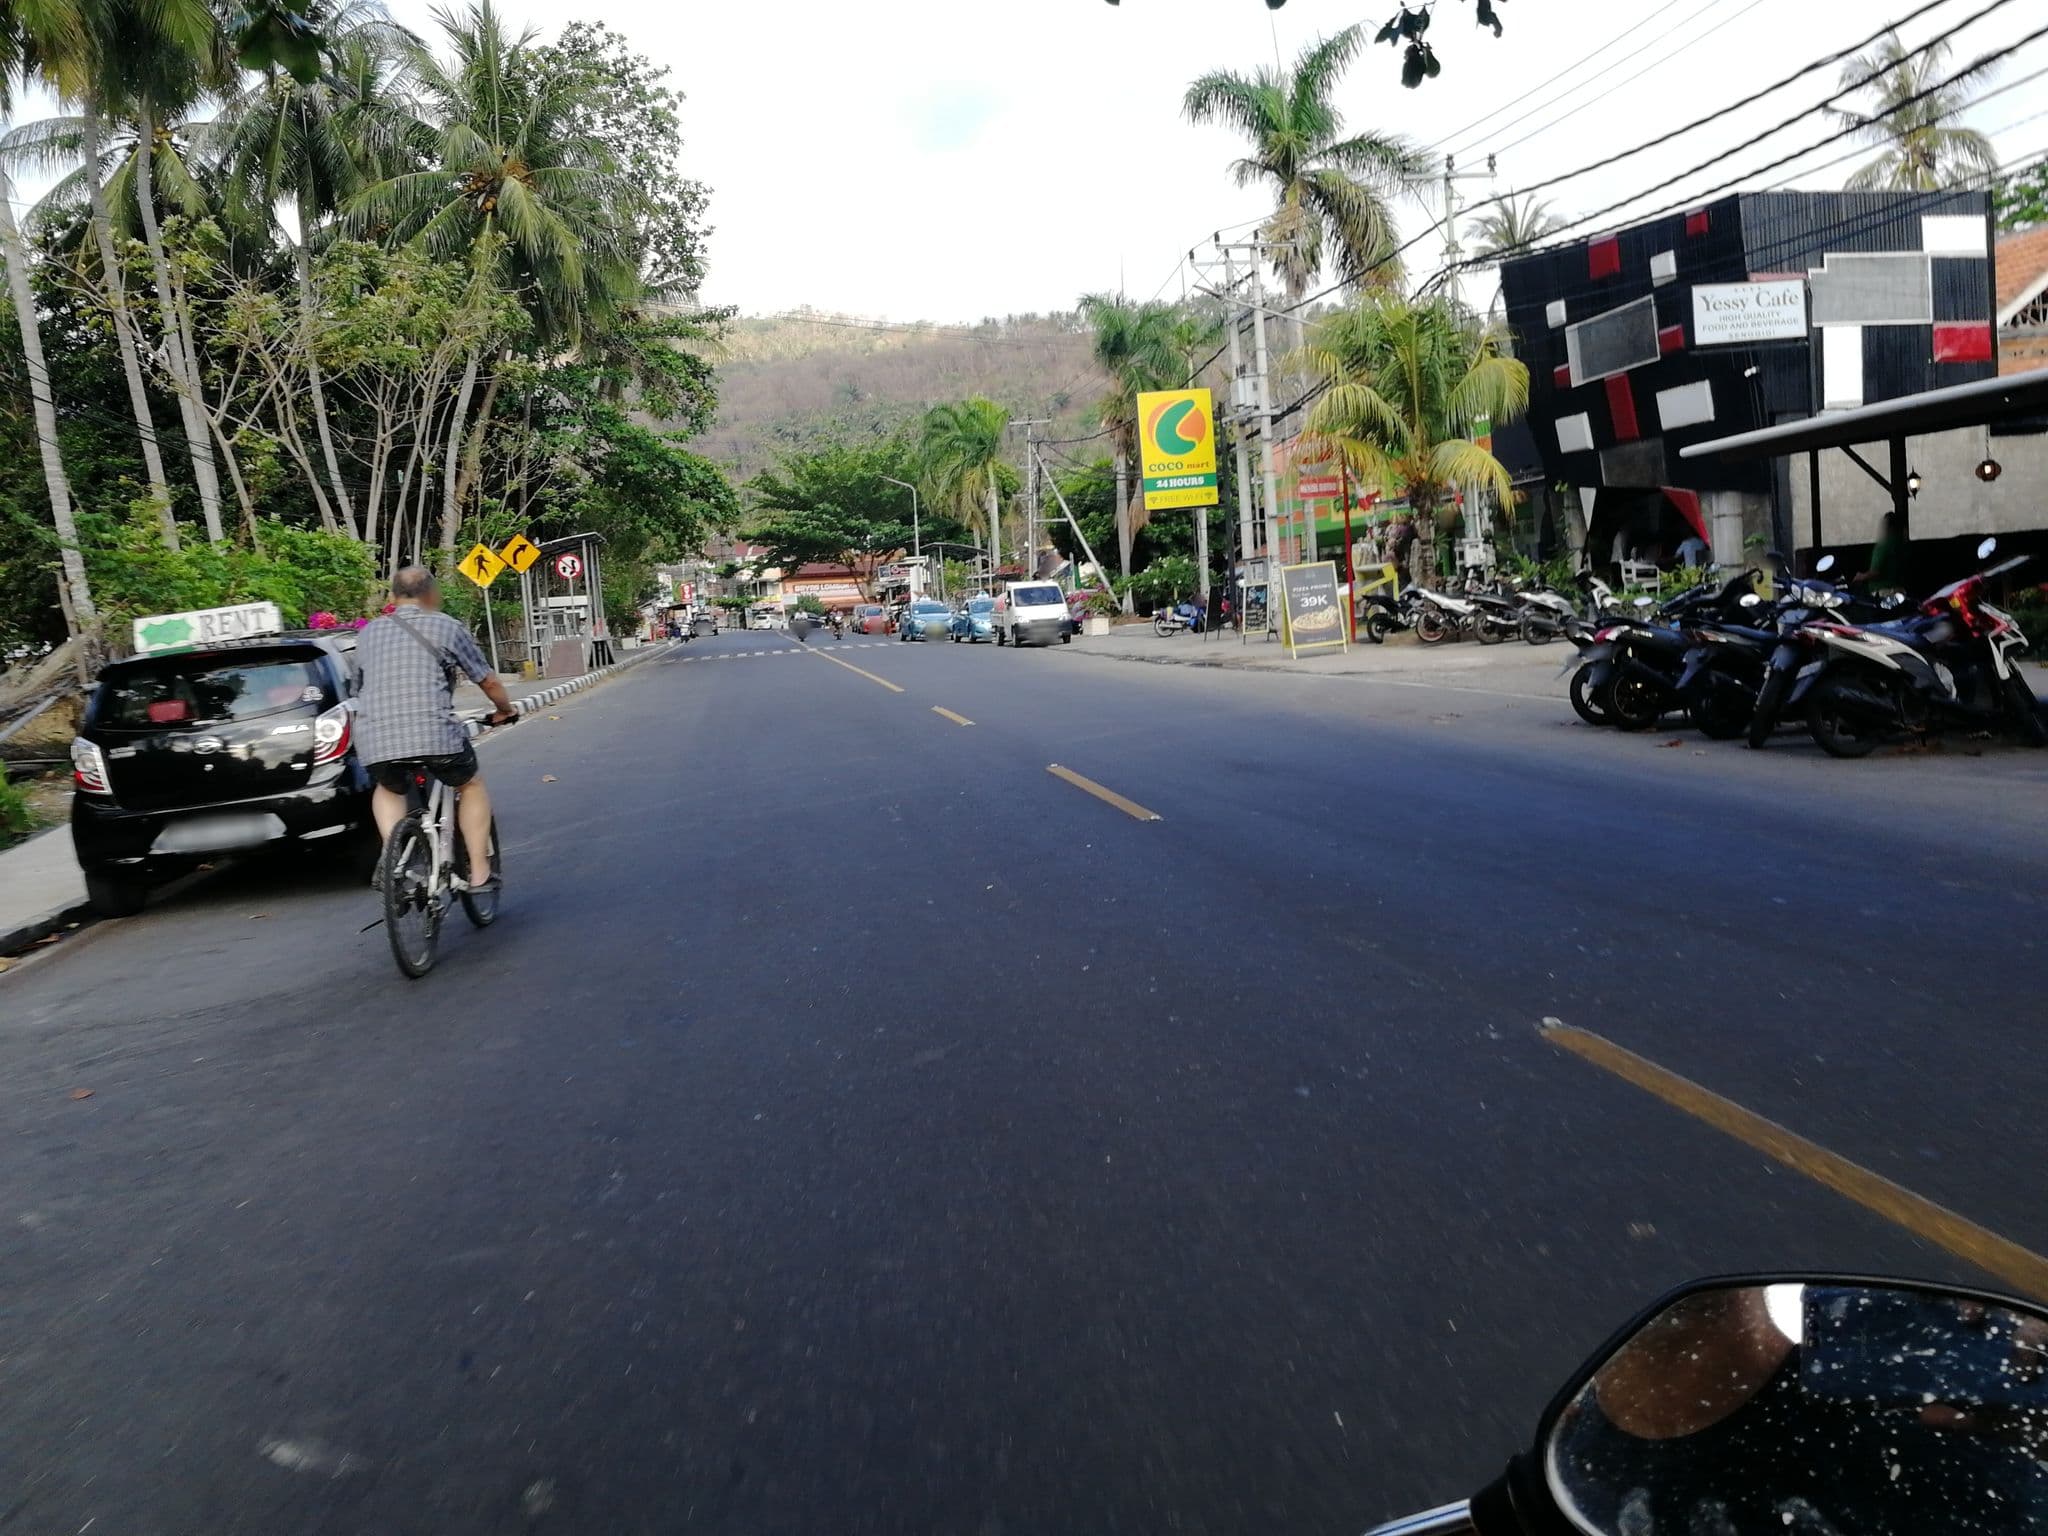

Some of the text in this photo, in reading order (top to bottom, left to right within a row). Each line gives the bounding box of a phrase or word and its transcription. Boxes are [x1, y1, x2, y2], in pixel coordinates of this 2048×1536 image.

[1701, 294, 1747, 312] Yessy
[1719, 311, 1781, 323] HIGH QUALITY
[1702, 317, 1799, 332] FOOD AND BEVERAGE
[1149, 461, 1209, 472] COCO mart
[1156, 476, 1204, 488] 24 HOURS
[1301, 594, 1328, 608] 39K
[198, 607, 266, 638] RENT
